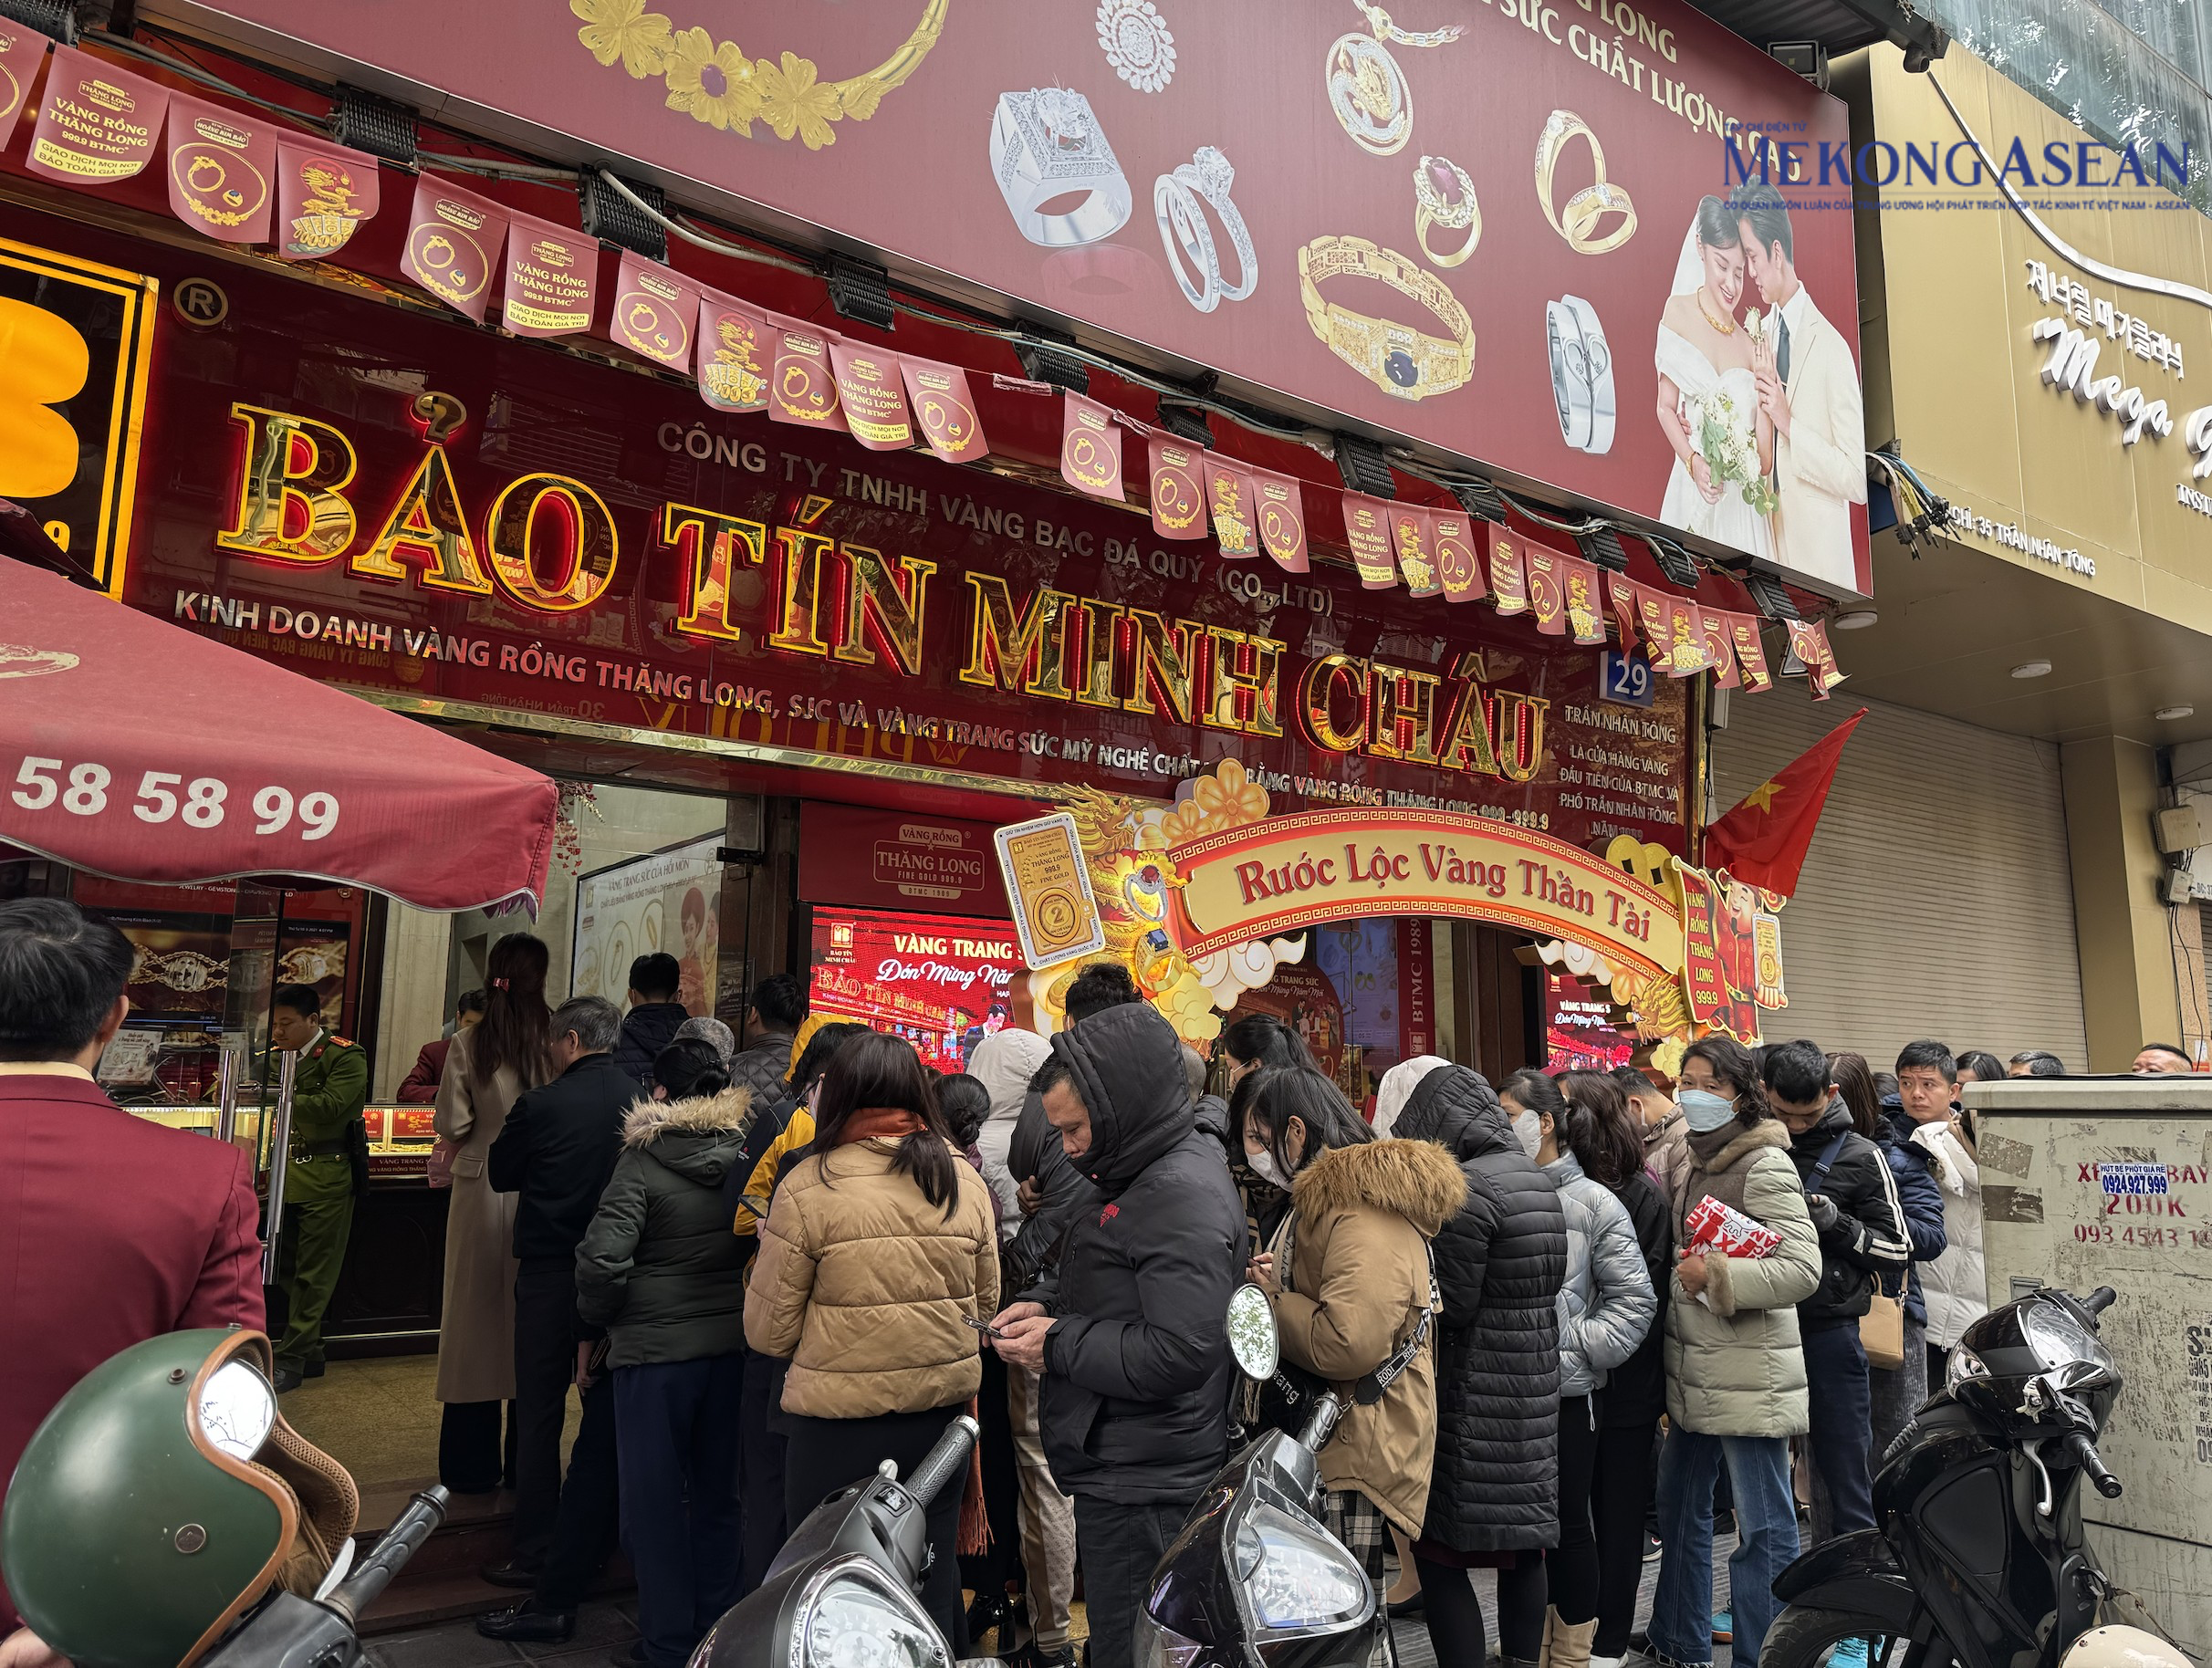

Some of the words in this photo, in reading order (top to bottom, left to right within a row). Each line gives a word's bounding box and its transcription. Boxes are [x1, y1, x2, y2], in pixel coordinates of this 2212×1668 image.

[1598, 0, 1677, 63] LONG
[56, 97, 100, 123] VÀNG
[103, 113, 149, 137] RỒNG
[1568, 35, 1644, 93] CHẤT
[1650, 68, 1743, 150] LƯỢNG
[1748, 130, 1801, 182] CAO
[48, 108, 104, 139] THĂNG
[106, 130, 149, 148] LONG
[61, 130, 88, 146] 999.9
[38, 150, 65, 171] BẢO
[66, 162, 96, 175] TOÀN
[41, 142, 69, 161] GIAO
[70, 153, 98, 169] DỊCH
[99, 161, 118, 170] MỌI
[513, 271, 553, 293] THĂNG
[556, 284, 590, 298] LONG
[516, 261, 549, 278] VÀNG
[552, 270, 587, 288] RỒNG
[2032, 317, 2174, 445] Mega
[657, 422, 767, 474] CÔNG
[779, 452, 830, 494] TY
[840, 466, 928, 518] TNHH
[940, 492, 1026, 540] VÀNG
[1035, 519, 1094, 558] BẠC
[1104, 537, 1142, 569] ĐÁ
[1149, 548, 1205, 584] QUÝ
[1281, 580, 1334, 618] LTD)
[1976, 516, 1993, 538] 35
[1996, 521, 2029, 555] TRẦN
[2029, 537, 2062, 566] NHÂN
[2062, 547, 2097, 579] TÔNG
[213, 390, 621, 613] BẢO
[657, 497, 938, 676] TÍN
[958, 570, 1288, 738] MINH
[1298, 652, 1551, 783] CHÂU
[1613, 658, 1649, 697] 29
[173, 589, 261, 631] KINH
[267, 604, 392, 653] DOANH
[402, 625, 490, 667] VÀNG
[498, 640, 587, 683] RỒNG
[596, 661, 694, 701] THĂNG
[699, 678, 780, 719] LONG,
[788, 694, 832, 723] SJC
[839, 699, 869, 729] VÀ
[877, 705, 939, 740] VÀNG
[944, 719, 1015, 751] TRANG
[1017, 730, 1059, 759] SỨC
[1061, 736, 1093, 764] MỸ
[1097, 745, 1150, 780] NGHỆ
[1246, 762, 1291, 793] BẰNG
[1293, 773, 1338, 800] VÀNG
[1339, 777, 1383, 807] RỒNG
[1387, 787, 1437, 810] THĂNG
[1565, 704, 1601, 728] TRẦN
[1602, 714, 1639, 736] NHÂN
[1641, 720, 1677, 744] TÔNG
[1569, 744, 1585, 761] LÀ
[1586, 745, 1607, 766] CỬA
[1609, 751, 1640, 771] HÀNG
[1642, 757, 1670, 777] VÀNG
[1560, 765, 1583, 785] ĐẦU
[1585, 771, 1610, 790] TIÊN
[1611, 775, 1633, 794] CỦA
[1634, 780, 1665, 799] BTMC
[1666, 785, 1680, 802] VÀ
[11, 754, 111, 817] 58
[132, 769, 230, 829] 58
[252, 785, 341, 842] 99
[1559, 791, 1583, 809] PHỐ
[1584, 794, 1614, 815] TRẦN
[1615, 801, 1646, 820] NHÂN
[1648, 806, 1677, 825] TÔNG
[903, 828, 930, 840] VÀNG
[932, 829, 959, 843] RỒNG
[877, 850, 934, 871] THĂNG
[939, 858, 982, 876] LONG
[1031, 857, 1053, 868] THĂNG
[1054, 853, 1069, 862] LONG
[1044, 864, 1060, 874] 999.9
[898, 870, 915, 881] FINE
[918, 872, 937, 882] GOLD
[941, 874, 963, 884] 999.9
[1040, 875, 1054, 884] FINE
[1054, 870, 1069, 881] GOLD
[1236, 849, 1338, 906] Rước
[1346, 841, 1411, 891] Lộc
[1418, 841, 1508, 898] Vàng
[1518, 859, 1595, 918] Thần
[1604, 888, 1651, 943] Tài
[1686, 891, 1706, 909] VÀNG
[1051, 906, 1064, 924] 2
[1689, 912, 1709, 933] RỒNG
[893, 933, 948, 955] VÀNG
[952, 939, 1013, 960] TRANG
[1410, 918, 1422, 956] 1989
[1689, 941, 1715, 960] THĂNG
[876, 959, 920, 983] Đón
[920, 961, 976, 991] Mừng
[1280, 975, 1304, 985] TRANG
[1305, 975, 1320, 985] SỨC
[1696, 966, 1714, 984] LONG
[1410, 963, 1425, 1024] BTMC
[1696, 989, 1718, 1006] 999.9
[2102, 1174, 2167, 1194] 0924.927.999
[2106, 1194, 2186, 1217] 200K
[2074, 1224, 2114, 1244] 093
[2122, 1225, 2179, 1249] 4543
